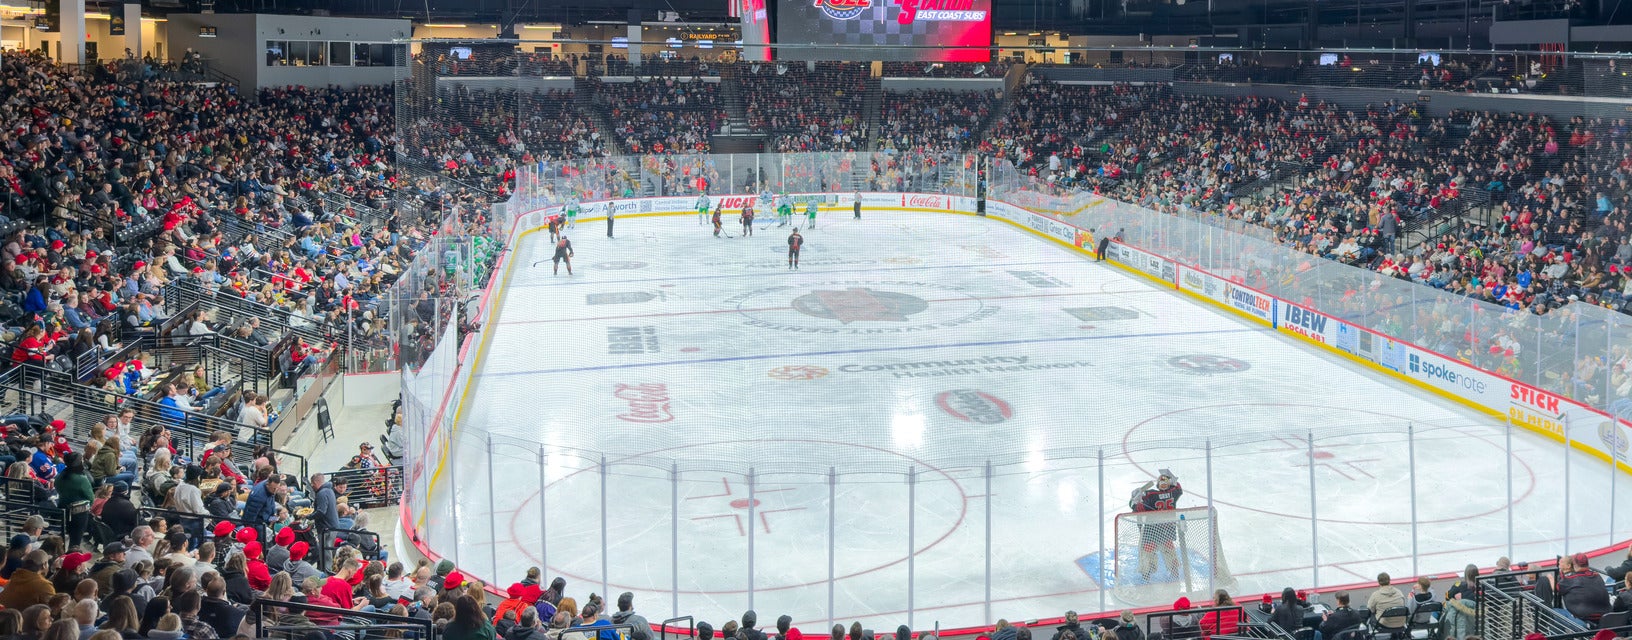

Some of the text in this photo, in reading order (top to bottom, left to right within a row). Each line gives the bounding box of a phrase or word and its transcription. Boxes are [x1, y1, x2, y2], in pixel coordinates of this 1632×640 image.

[917, 11, 984, 20] EAST COAST SUBS
[1285, 304, 1328, 334] IBEW
[1284, 322, 1309, 337] LOCAL
[1311, 331, 1326, 344] 481
[838, 355, 1029, 373] Community
[893, 360, 1096, 379] Health Network
[1422, 361, 1485, 394] spokenote
[1510, 384, 1559, 415] STICK
[1527, 415, 1565, 437] MEDIA
